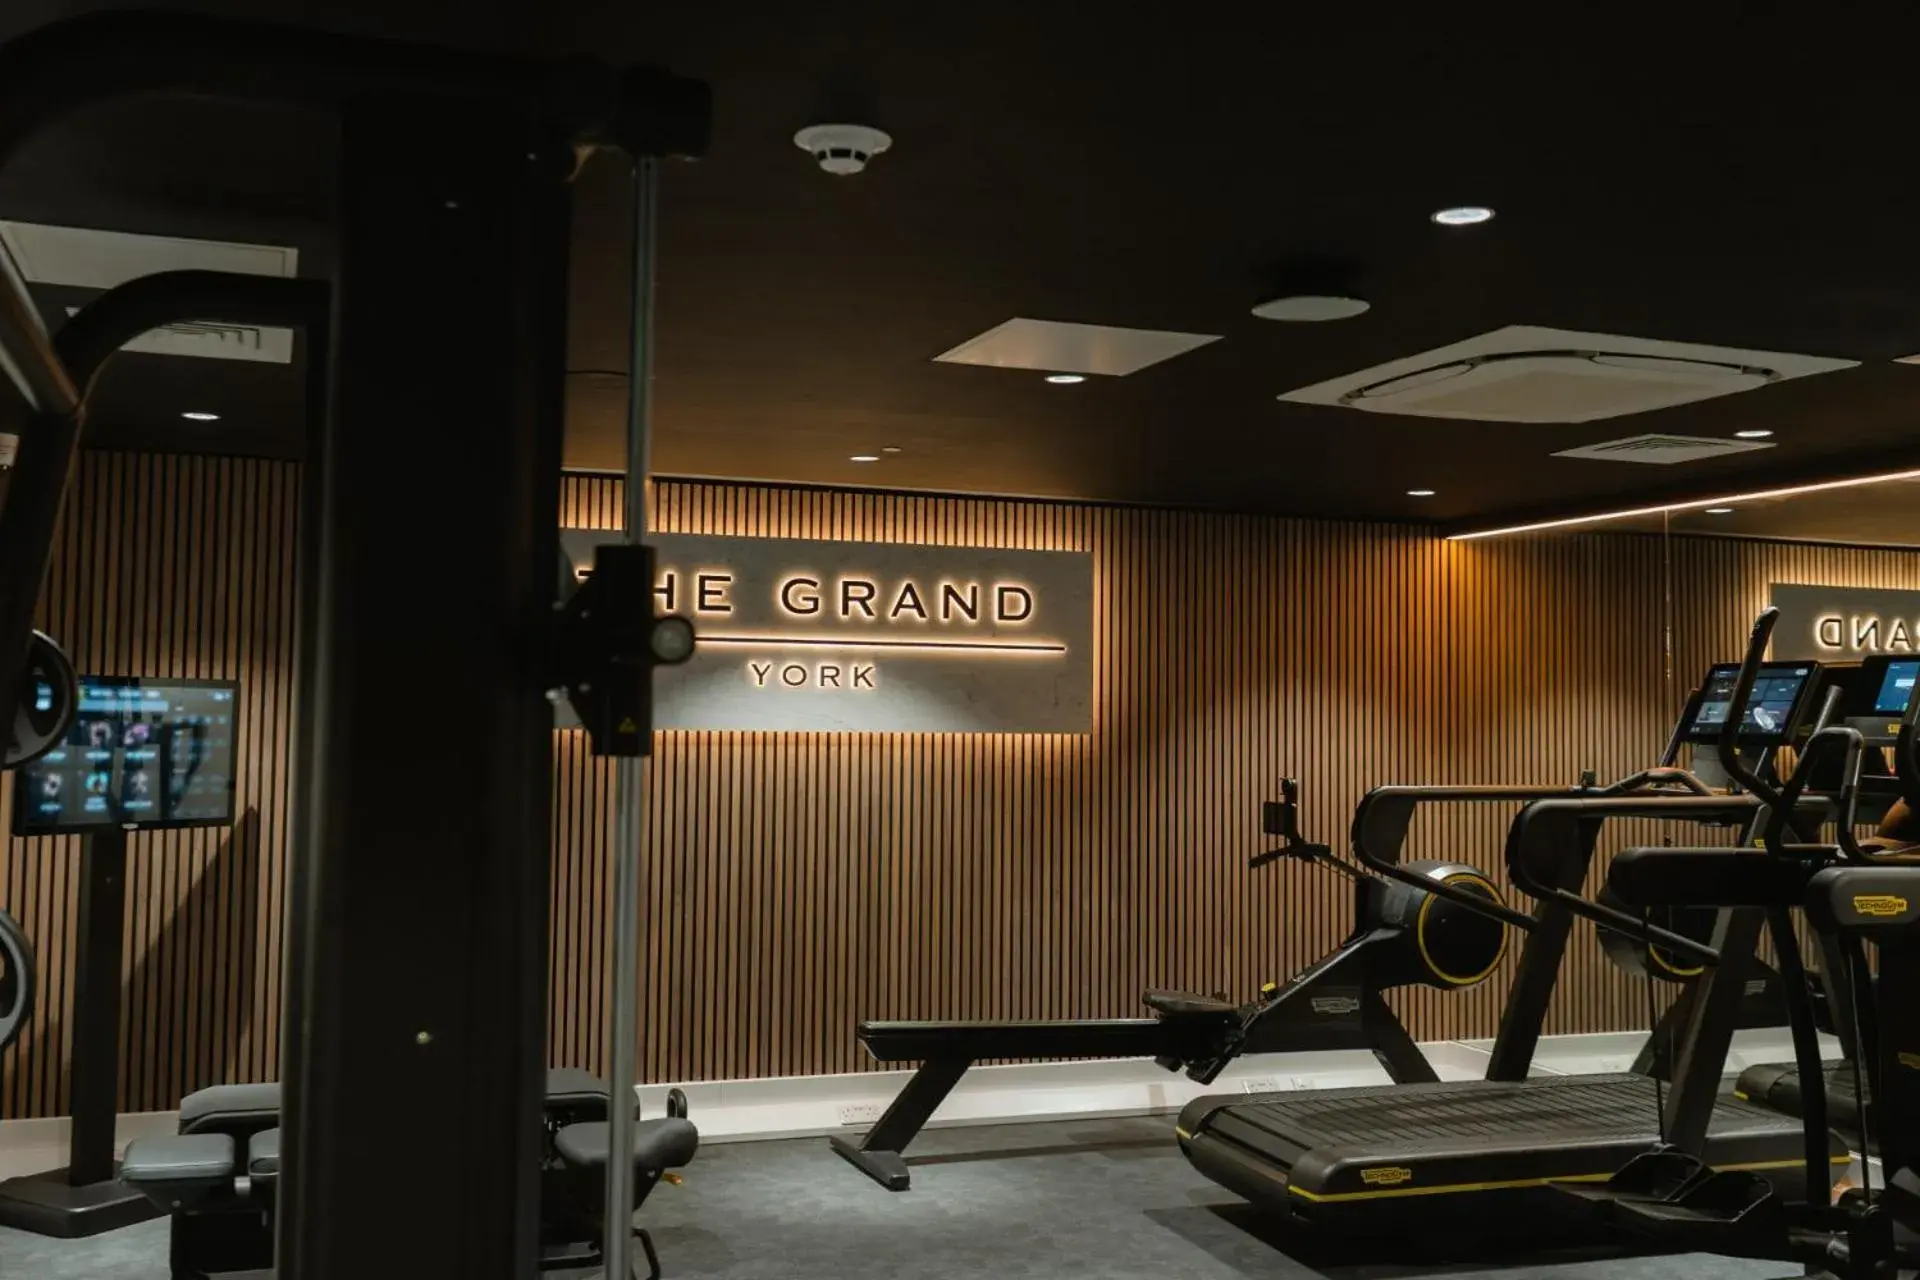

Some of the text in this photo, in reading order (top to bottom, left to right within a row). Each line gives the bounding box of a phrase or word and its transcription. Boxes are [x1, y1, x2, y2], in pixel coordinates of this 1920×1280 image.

[578, 570, 1033, 621] HE GRAND
[751, 663, 875, 688] YORK
